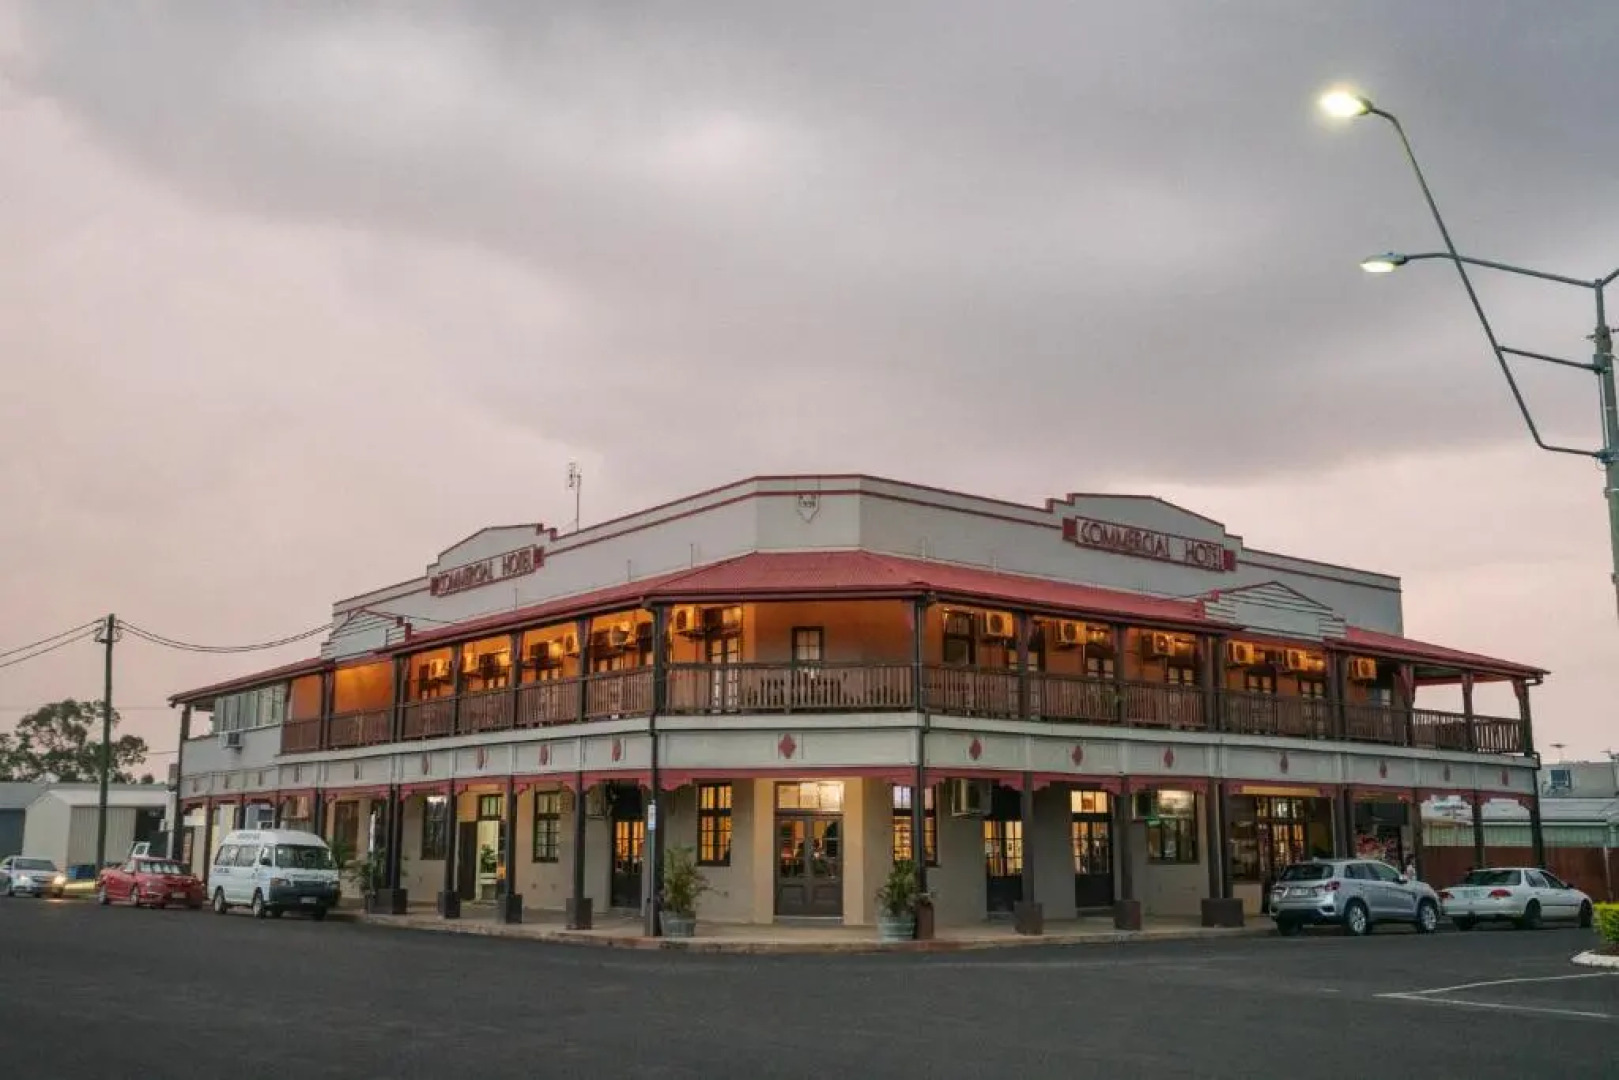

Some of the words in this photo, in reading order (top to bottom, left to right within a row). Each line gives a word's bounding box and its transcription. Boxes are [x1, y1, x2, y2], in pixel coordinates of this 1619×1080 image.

[502, 549, 534, 577] HOTEL
[1081, 520, 1170, 557] COMMERCIAL
[1185, 540, 1222, 569] HOTEL
